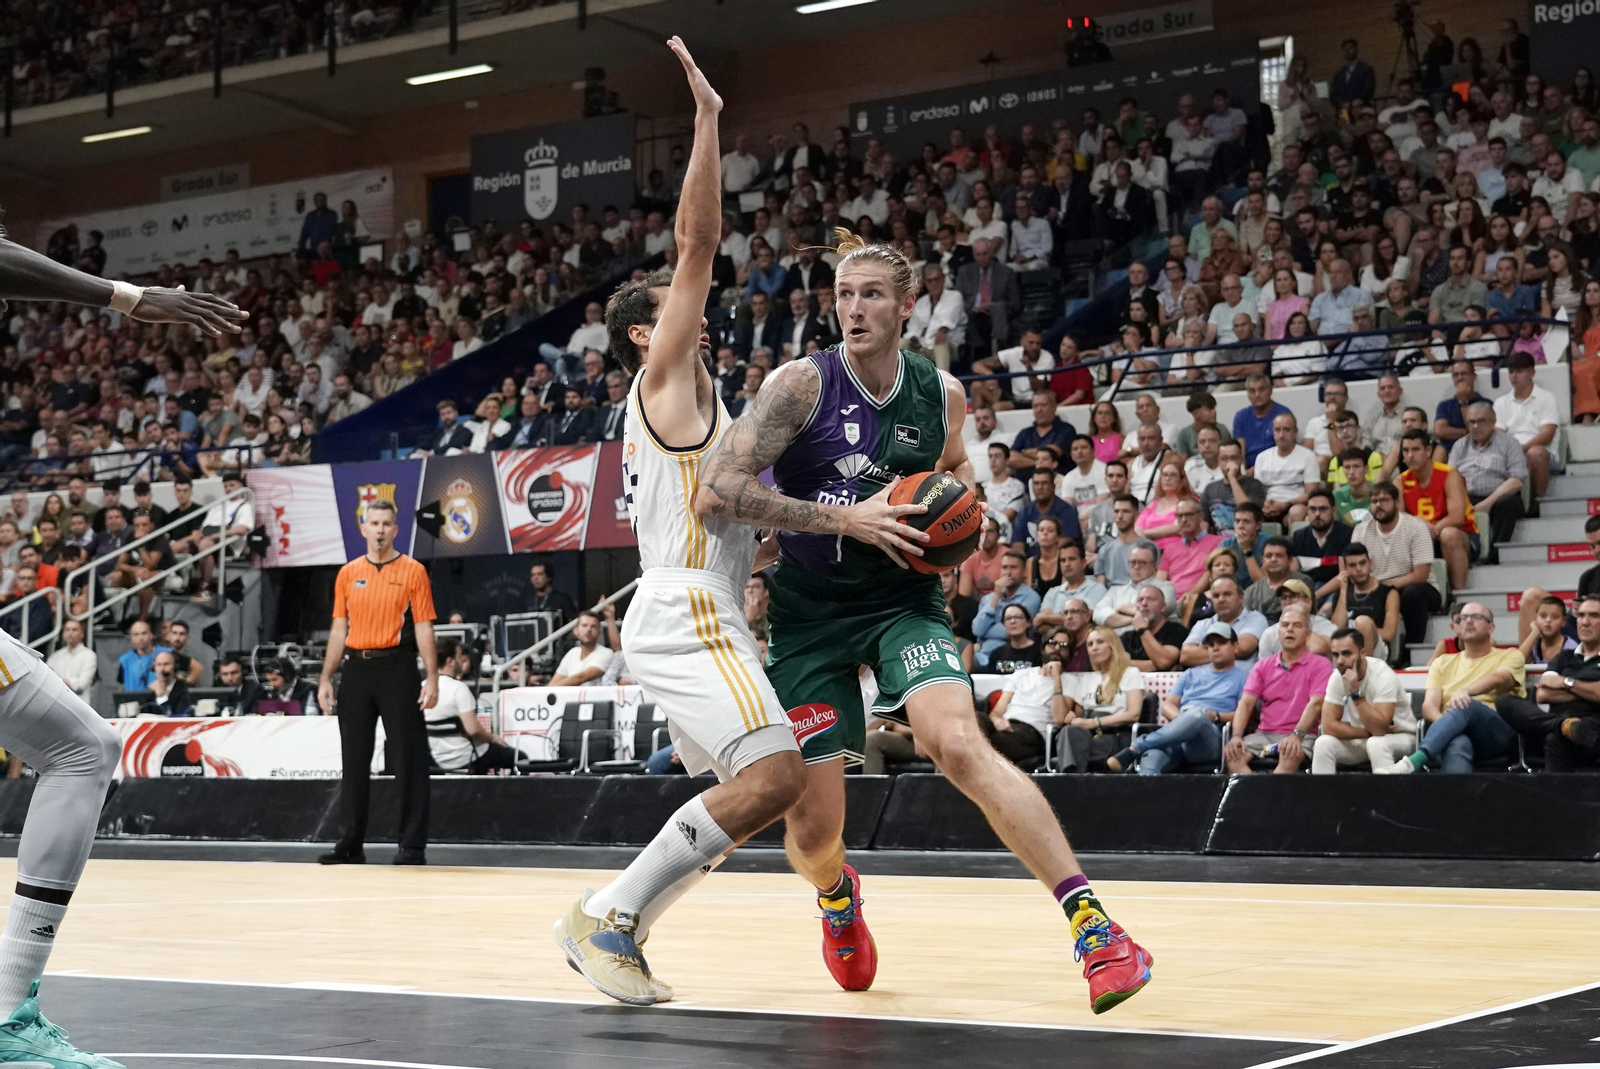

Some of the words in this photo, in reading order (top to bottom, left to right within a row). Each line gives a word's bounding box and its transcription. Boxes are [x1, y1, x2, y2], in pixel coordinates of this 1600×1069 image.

[1163, 12, 1195, 29] Sur
[909, 104, 960, 122] endesa
[473, 172, 521, 193] Región
[561, 163, 580, 179] de
[583, 156, 632, 176] Murcia
[202, 207, 252, 228] endesa
[897, 436, 918, 445] endesa
[531, 498, 563, 508] endesa
[1417, 497, 1434, 520] 6
[514, 704, 549, 722] acb
[162, 765, 202, 776] supercopa
